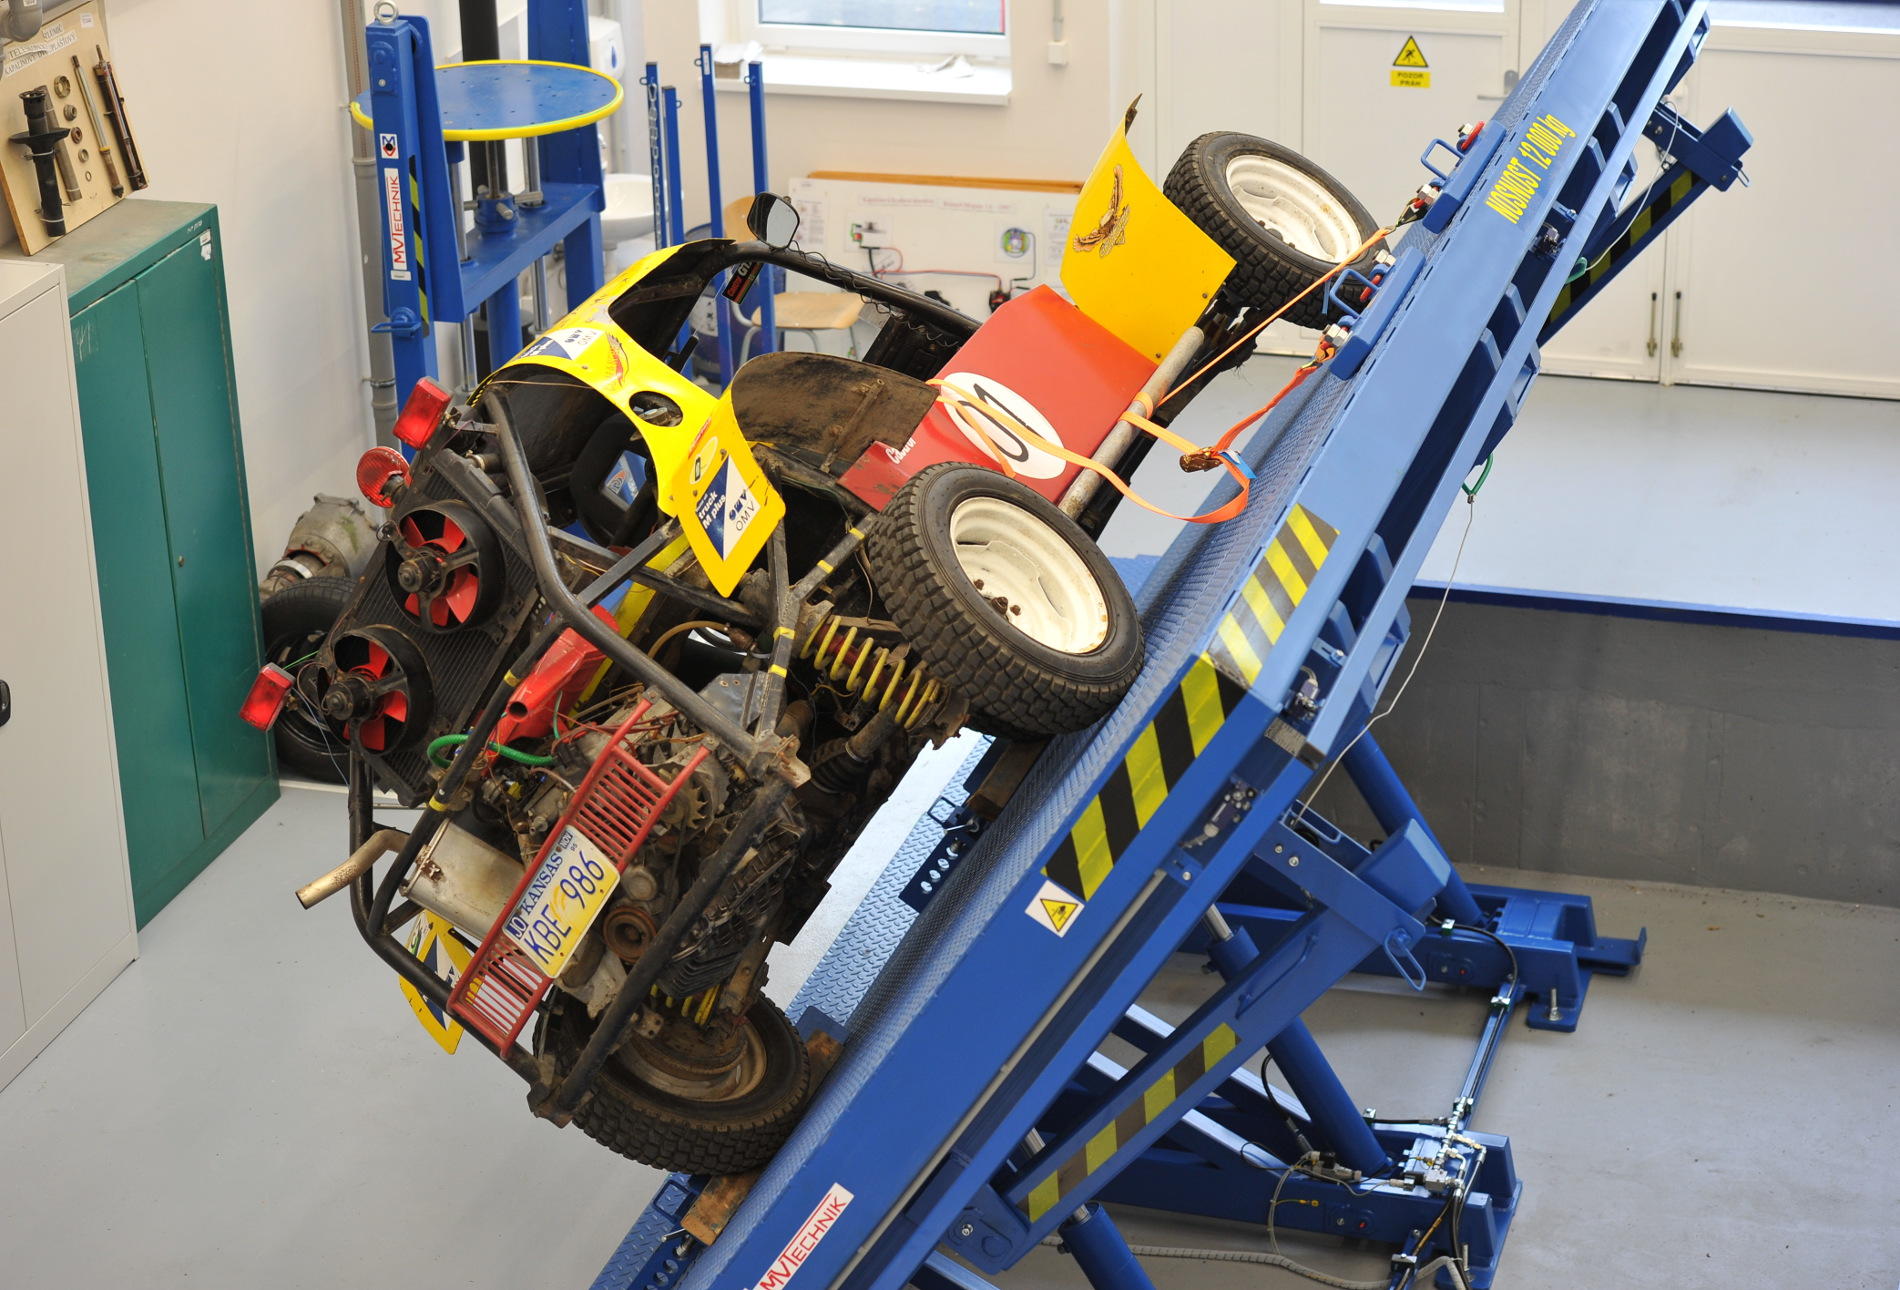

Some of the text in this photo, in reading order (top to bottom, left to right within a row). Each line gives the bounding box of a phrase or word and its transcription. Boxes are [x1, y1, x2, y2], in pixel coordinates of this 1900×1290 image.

[1484, 114, 1576, 224] NOSNOST 12 000 kg
[387, 176, 405, 263] MVTECHNIK
[698, 490, 718, 520] truck
[702, 516, 713, 529] M
[710, 494, 726, 521] plus
[735, 501, 755, 531] OMV
[559, 831, 573, 849] NOV
[507, 853, 563, 938] JO KANSAS
[524, 851, 604, 964] KBE 986
